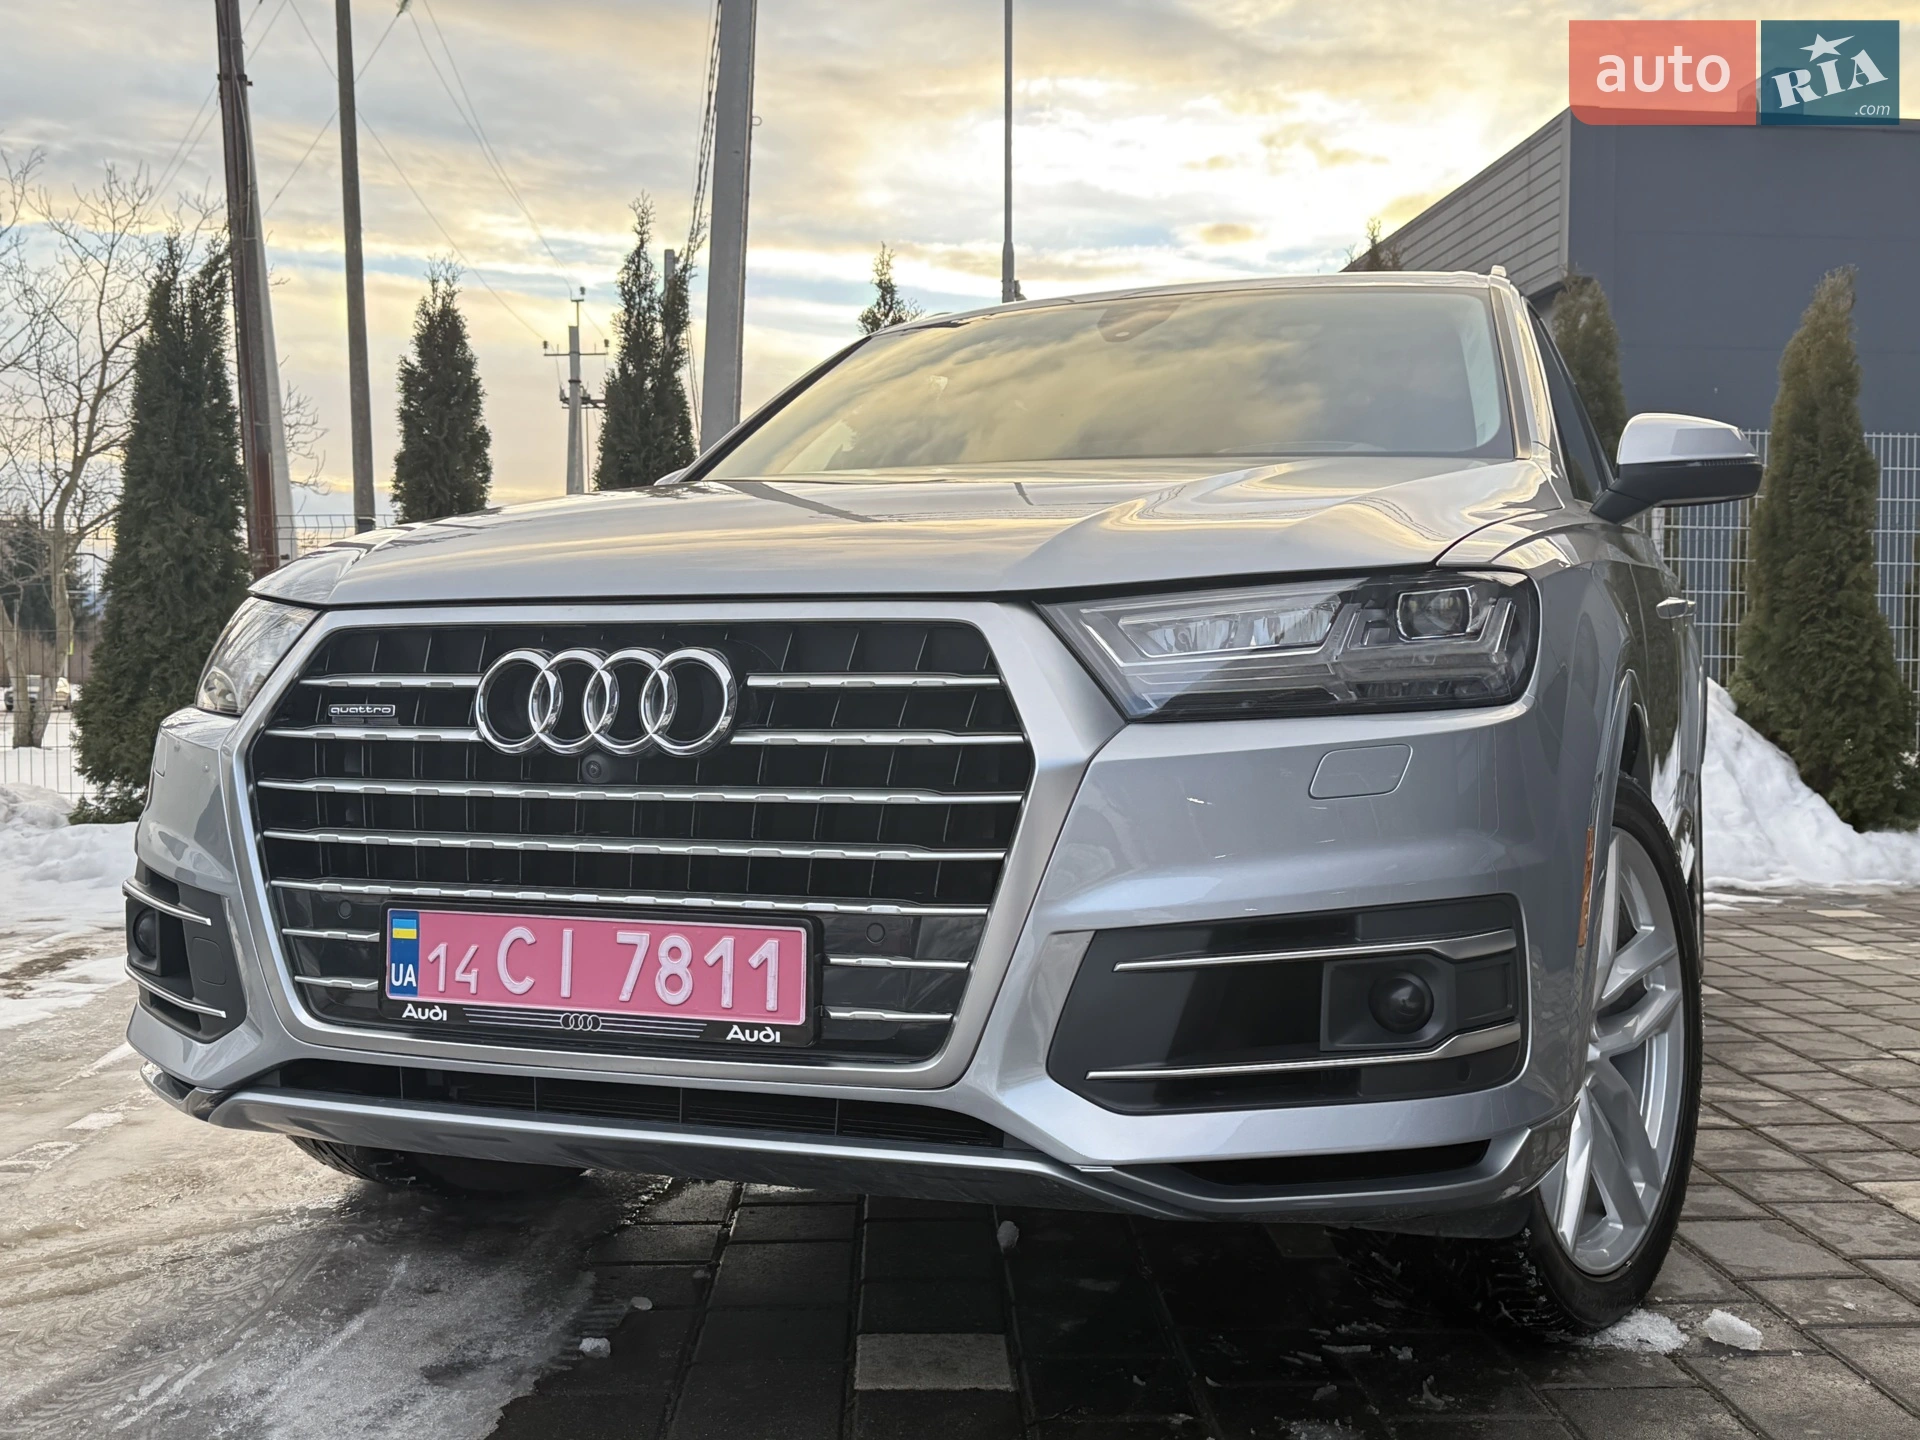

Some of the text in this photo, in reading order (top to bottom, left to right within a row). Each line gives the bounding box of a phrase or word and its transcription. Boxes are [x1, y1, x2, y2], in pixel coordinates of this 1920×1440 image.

[330, 706, 392, 715] quattro
[391, 962, 417, 988] UA
[427, 943, 479, 994] 14
[616, 932, 779, 1012] 7811
[402, 1004, 447, 1022] Audi
[726, 1025, 781, 1043] Audi
